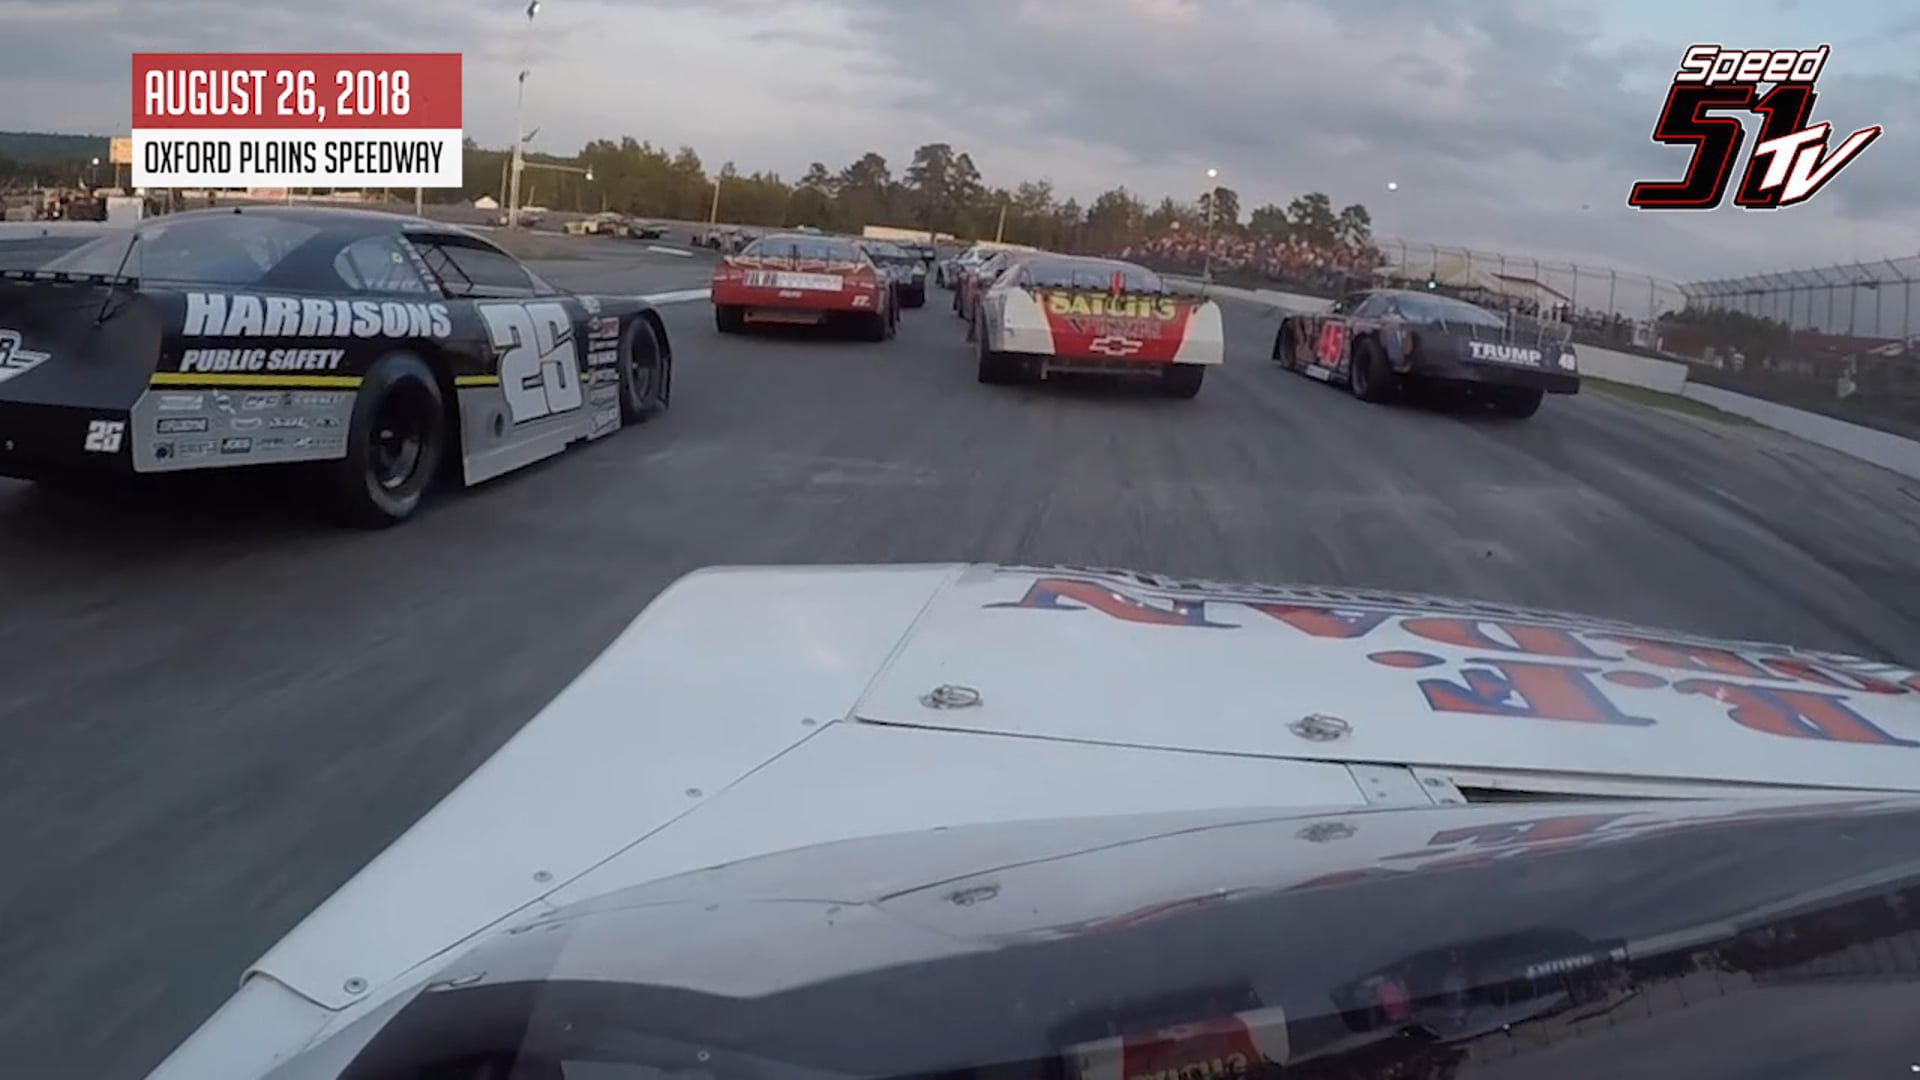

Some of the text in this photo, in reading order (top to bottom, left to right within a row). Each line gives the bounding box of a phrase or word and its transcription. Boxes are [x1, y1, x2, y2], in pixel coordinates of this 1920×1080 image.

[182, 292, 452, 339] HARRISONS
[179, 349, 345, 372] PUBLIC SAFETY
[478, 301, 583, 424] 26
[1469, 341, 1541, 365] TRUMP
